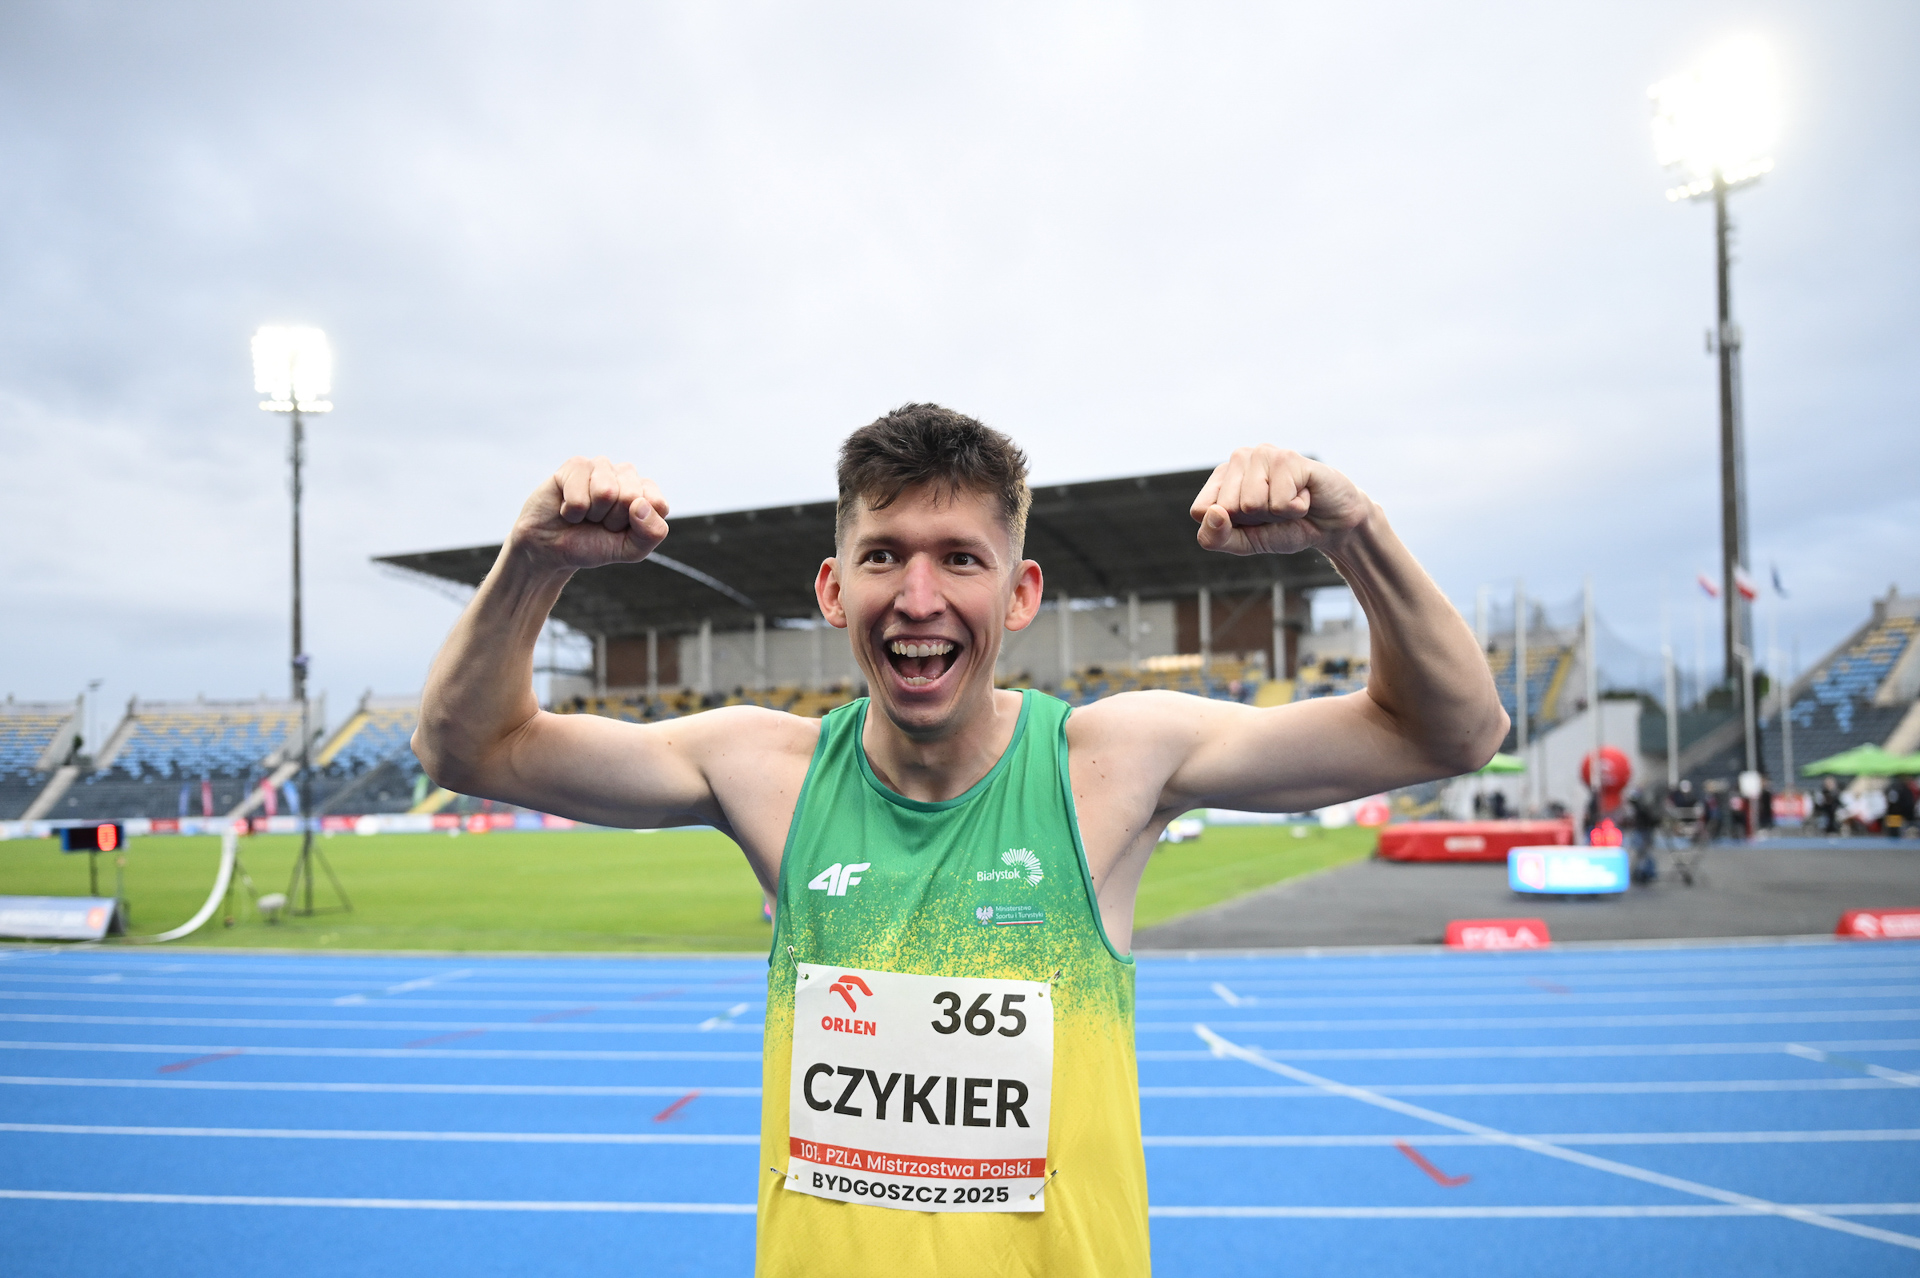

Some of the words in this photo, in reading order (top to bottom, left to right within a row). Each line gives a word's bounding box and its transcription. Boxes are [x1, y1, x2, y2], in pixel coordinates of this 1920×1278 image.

[808, 862, 871, 896] 4F
[821, 1016, 876, 1036] ORLEN
[931, 991, 1026, 1037] 365
[803, 1062, 1030, 1128] CZYKIER
[800, 1142, 821, 1162] 101.
[826, 1148, 862, 1168] PZLA
[867, 1154, 975, 1177] Mistrzostwa
[980, 1161, 1031, 1177] Polski
[812, 1172, 947, 1204] BYDGOSZCZ
[953, 1186, 1009, 1204] 2025
